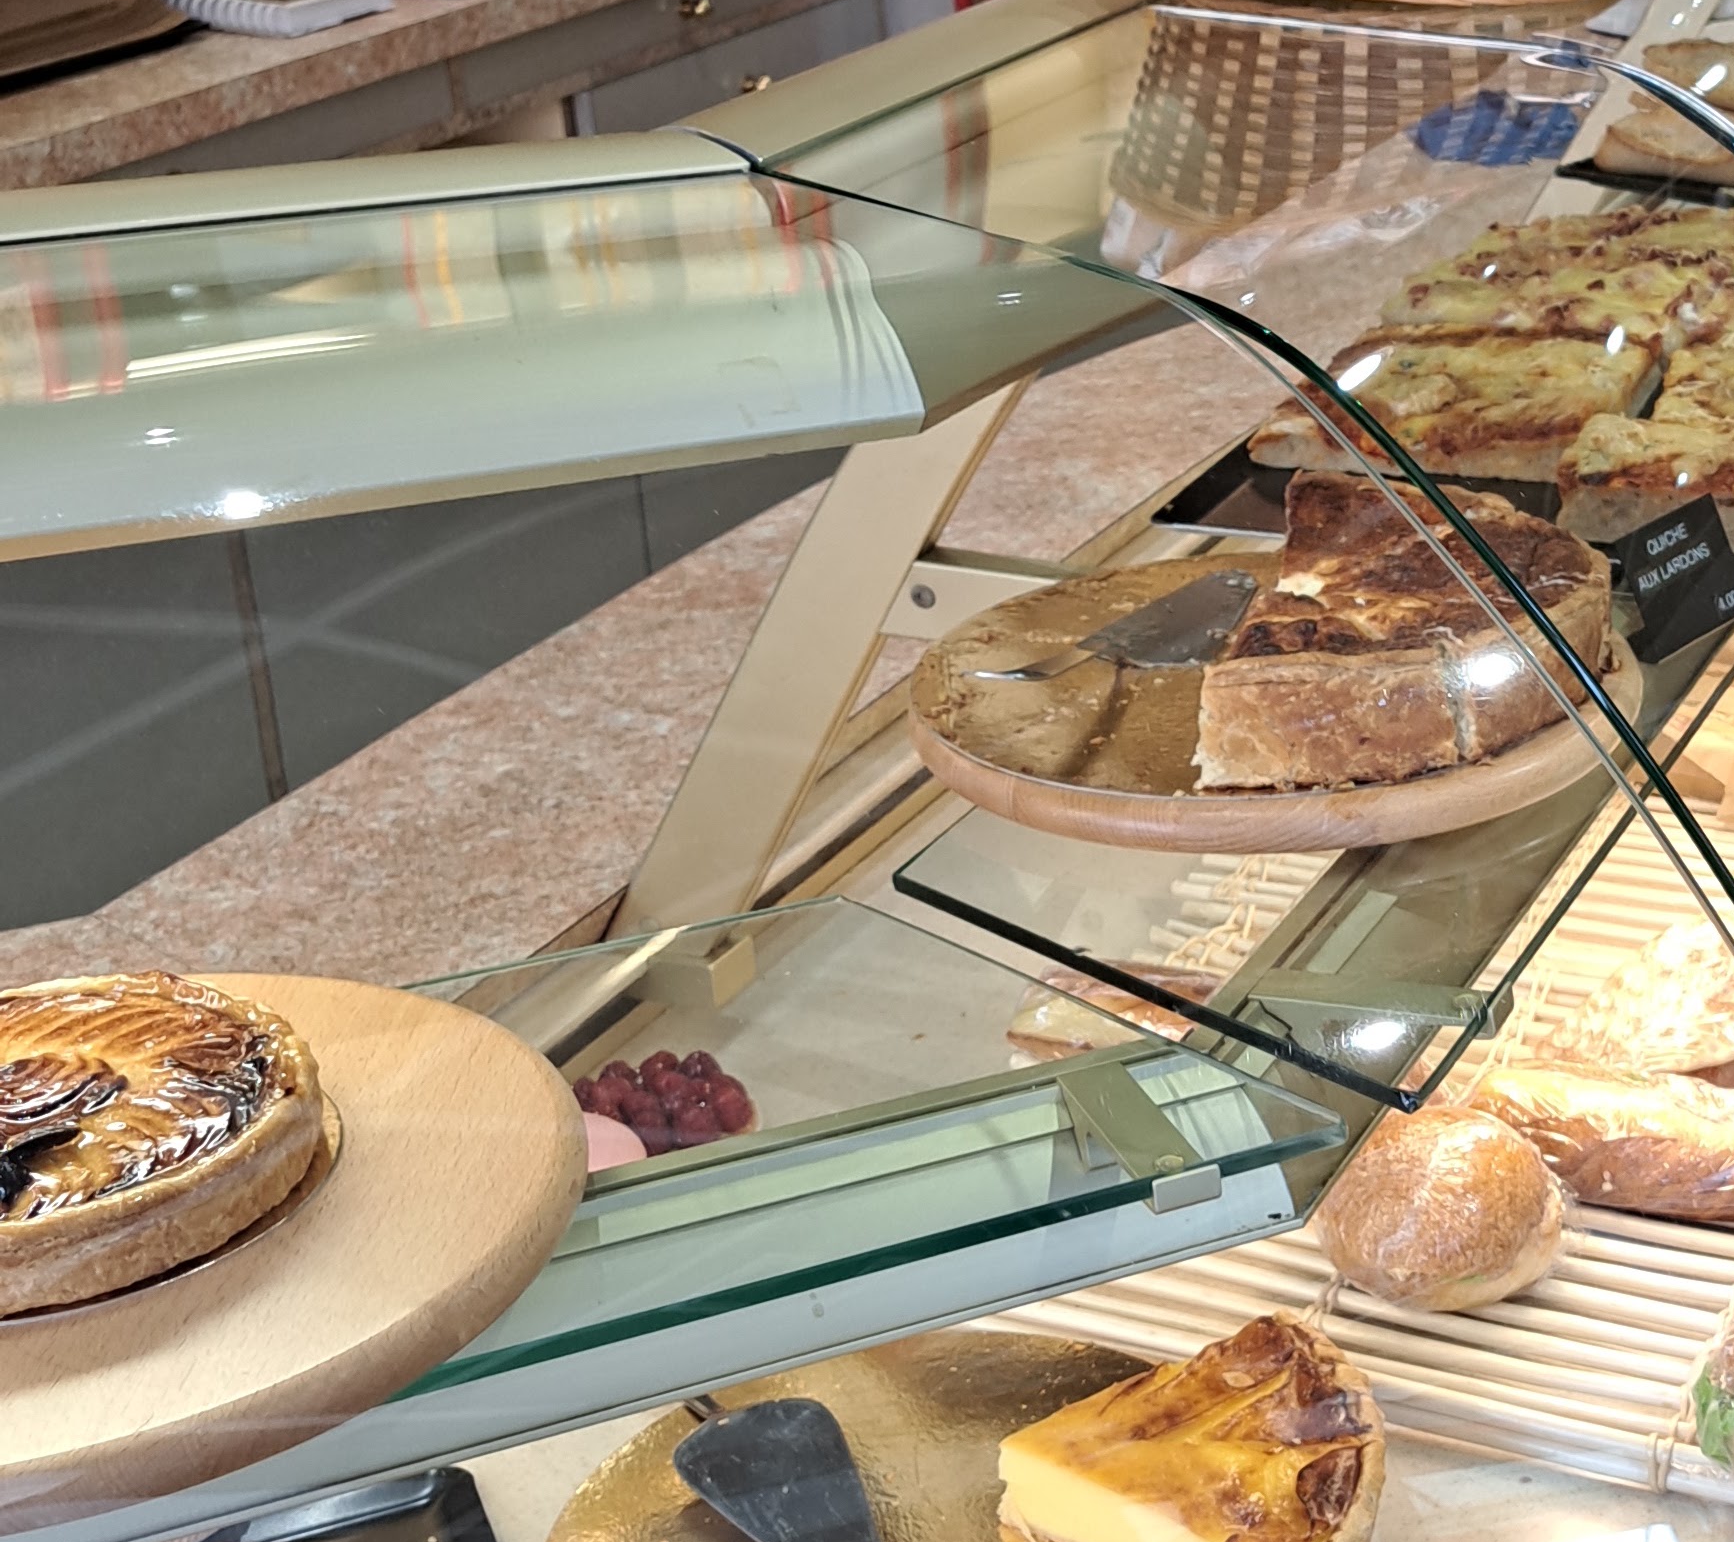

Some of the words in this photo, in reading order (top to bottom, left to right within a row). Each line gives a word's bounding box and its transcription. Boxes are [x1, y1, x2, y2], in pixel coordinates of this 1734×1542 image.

[1646, 522, 1689, 556] QUICHE
[1637, 571, 1662, 592] AUX
[1659, 541, 1712, 581] LARDONS
